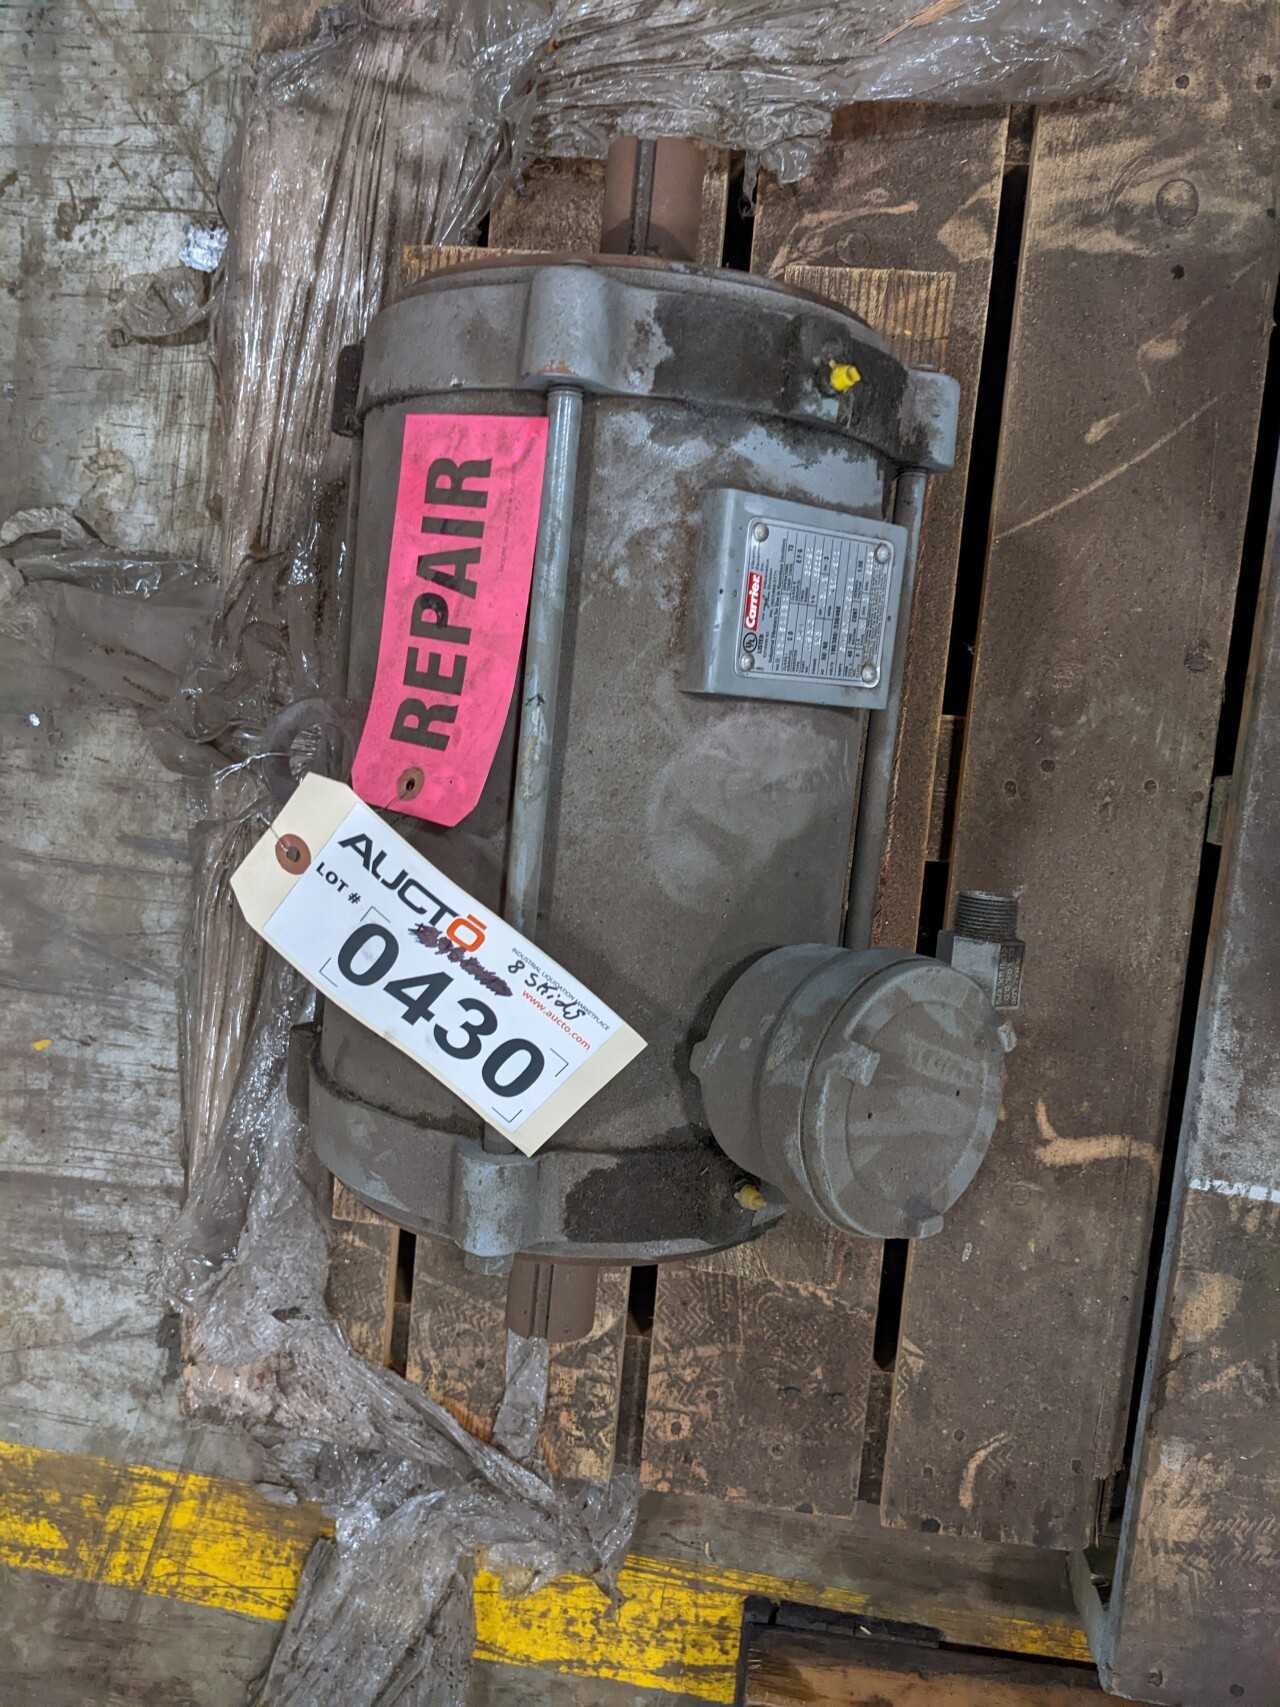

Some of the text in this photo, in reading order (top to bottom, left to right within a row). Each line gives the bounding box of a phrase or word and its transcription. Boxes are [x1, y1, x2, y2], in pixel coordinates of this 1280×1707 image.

[390, 458, 492, 752] REPAIR
[746, 574, 761, 629] Carrier
[316, 862, 361, 905] LOT #
[508, 959, 525, 974] 8
[337, 923, 546, 1098] 0430
[523, 990, 591, 1051] www.aucto.com
